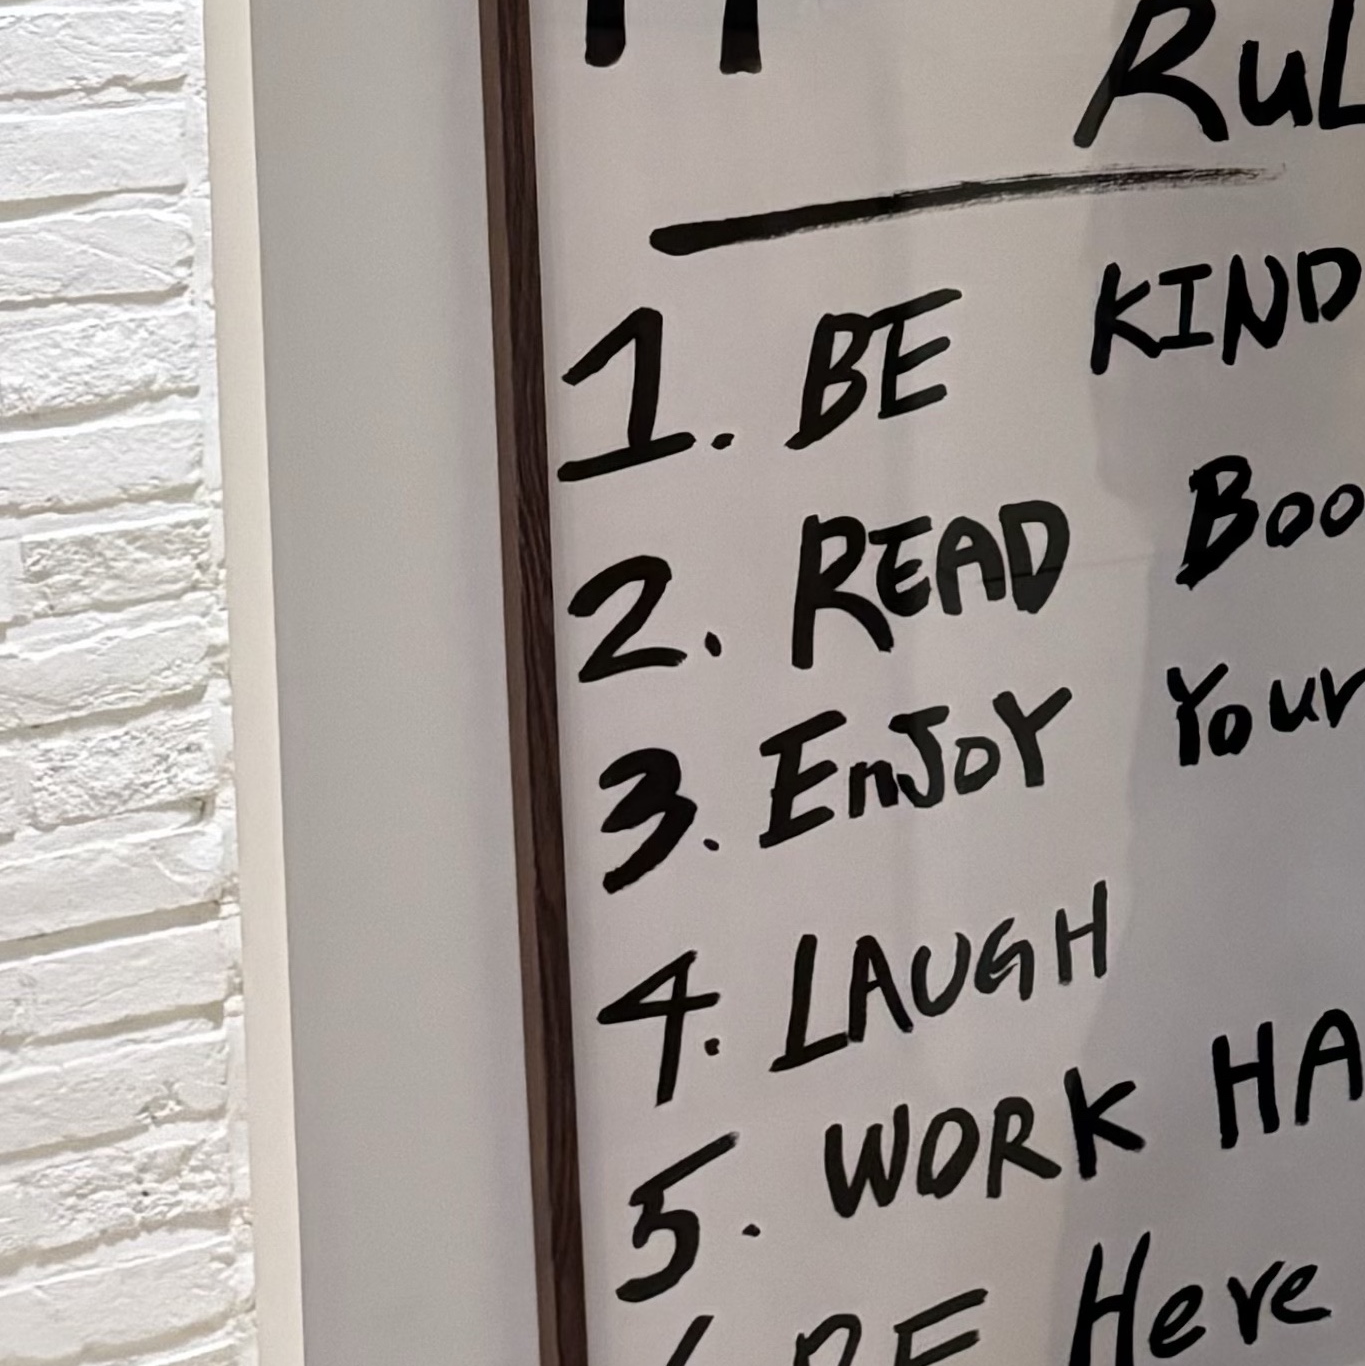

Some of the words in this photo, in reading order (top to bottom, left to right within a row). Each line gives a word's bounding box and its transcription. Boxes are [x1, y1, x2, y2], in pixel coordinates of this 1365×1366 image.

[556, 306, 736, 483] 1.
[784, 288, 964, 451] BE
[1090, 246, 1364, 376] KIND
[566, 554, 723, 684] 2.
[790, 499, 1071, 670] READ
[597, 747, 723, 895] 3.
[596, 950, 722, 1107] 4.
[768, 880, 1109, 1073] LAUGH
[615, 1132, 762, 1304] 5.
[823, 1065, 1147, 1220] WORK
